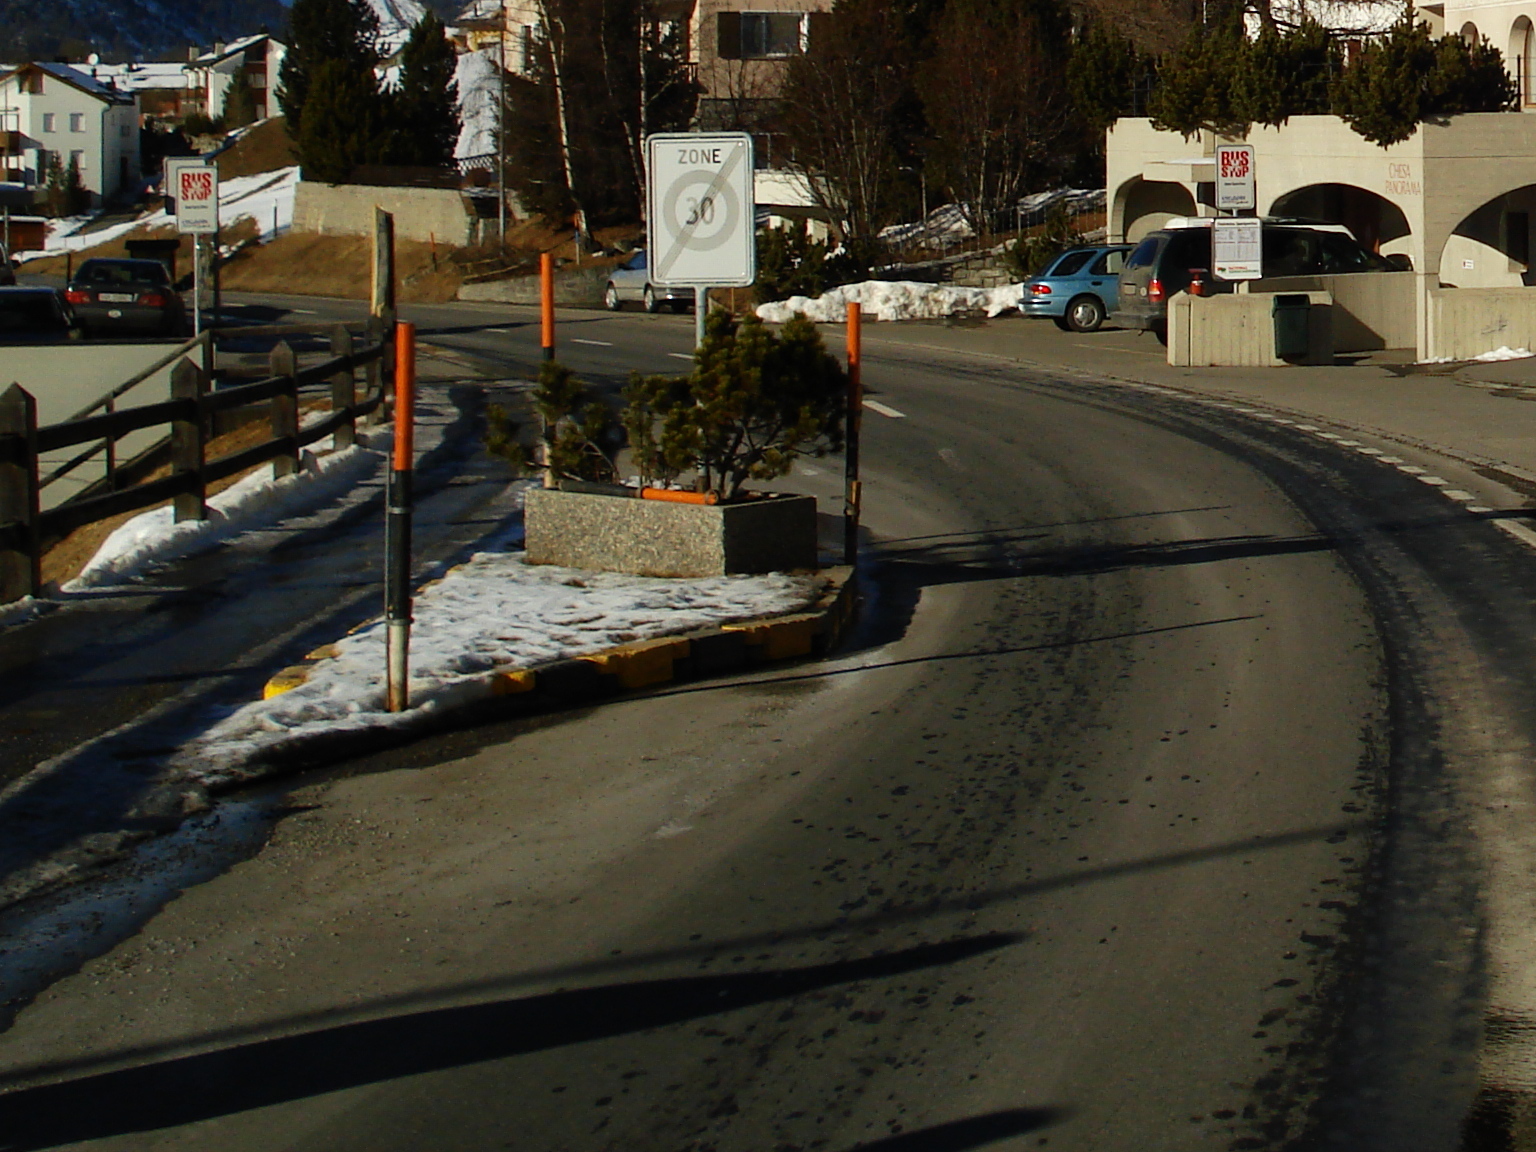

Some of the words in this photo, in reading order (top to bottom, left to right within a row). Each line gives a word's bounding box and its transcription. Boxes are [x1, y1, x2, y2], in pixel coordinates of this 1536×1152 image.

[678, 148, 722, 164] ZONE
[1221, 151, 1249, 166] BUS
[1221, 166, 1249, 178] STOP
[1389, 162, 1411, 179] CHESA
[181, 173, 212, 188] BUS
[181, 188, 212, 201] STOP
[686, 196, 715, 225] 30
